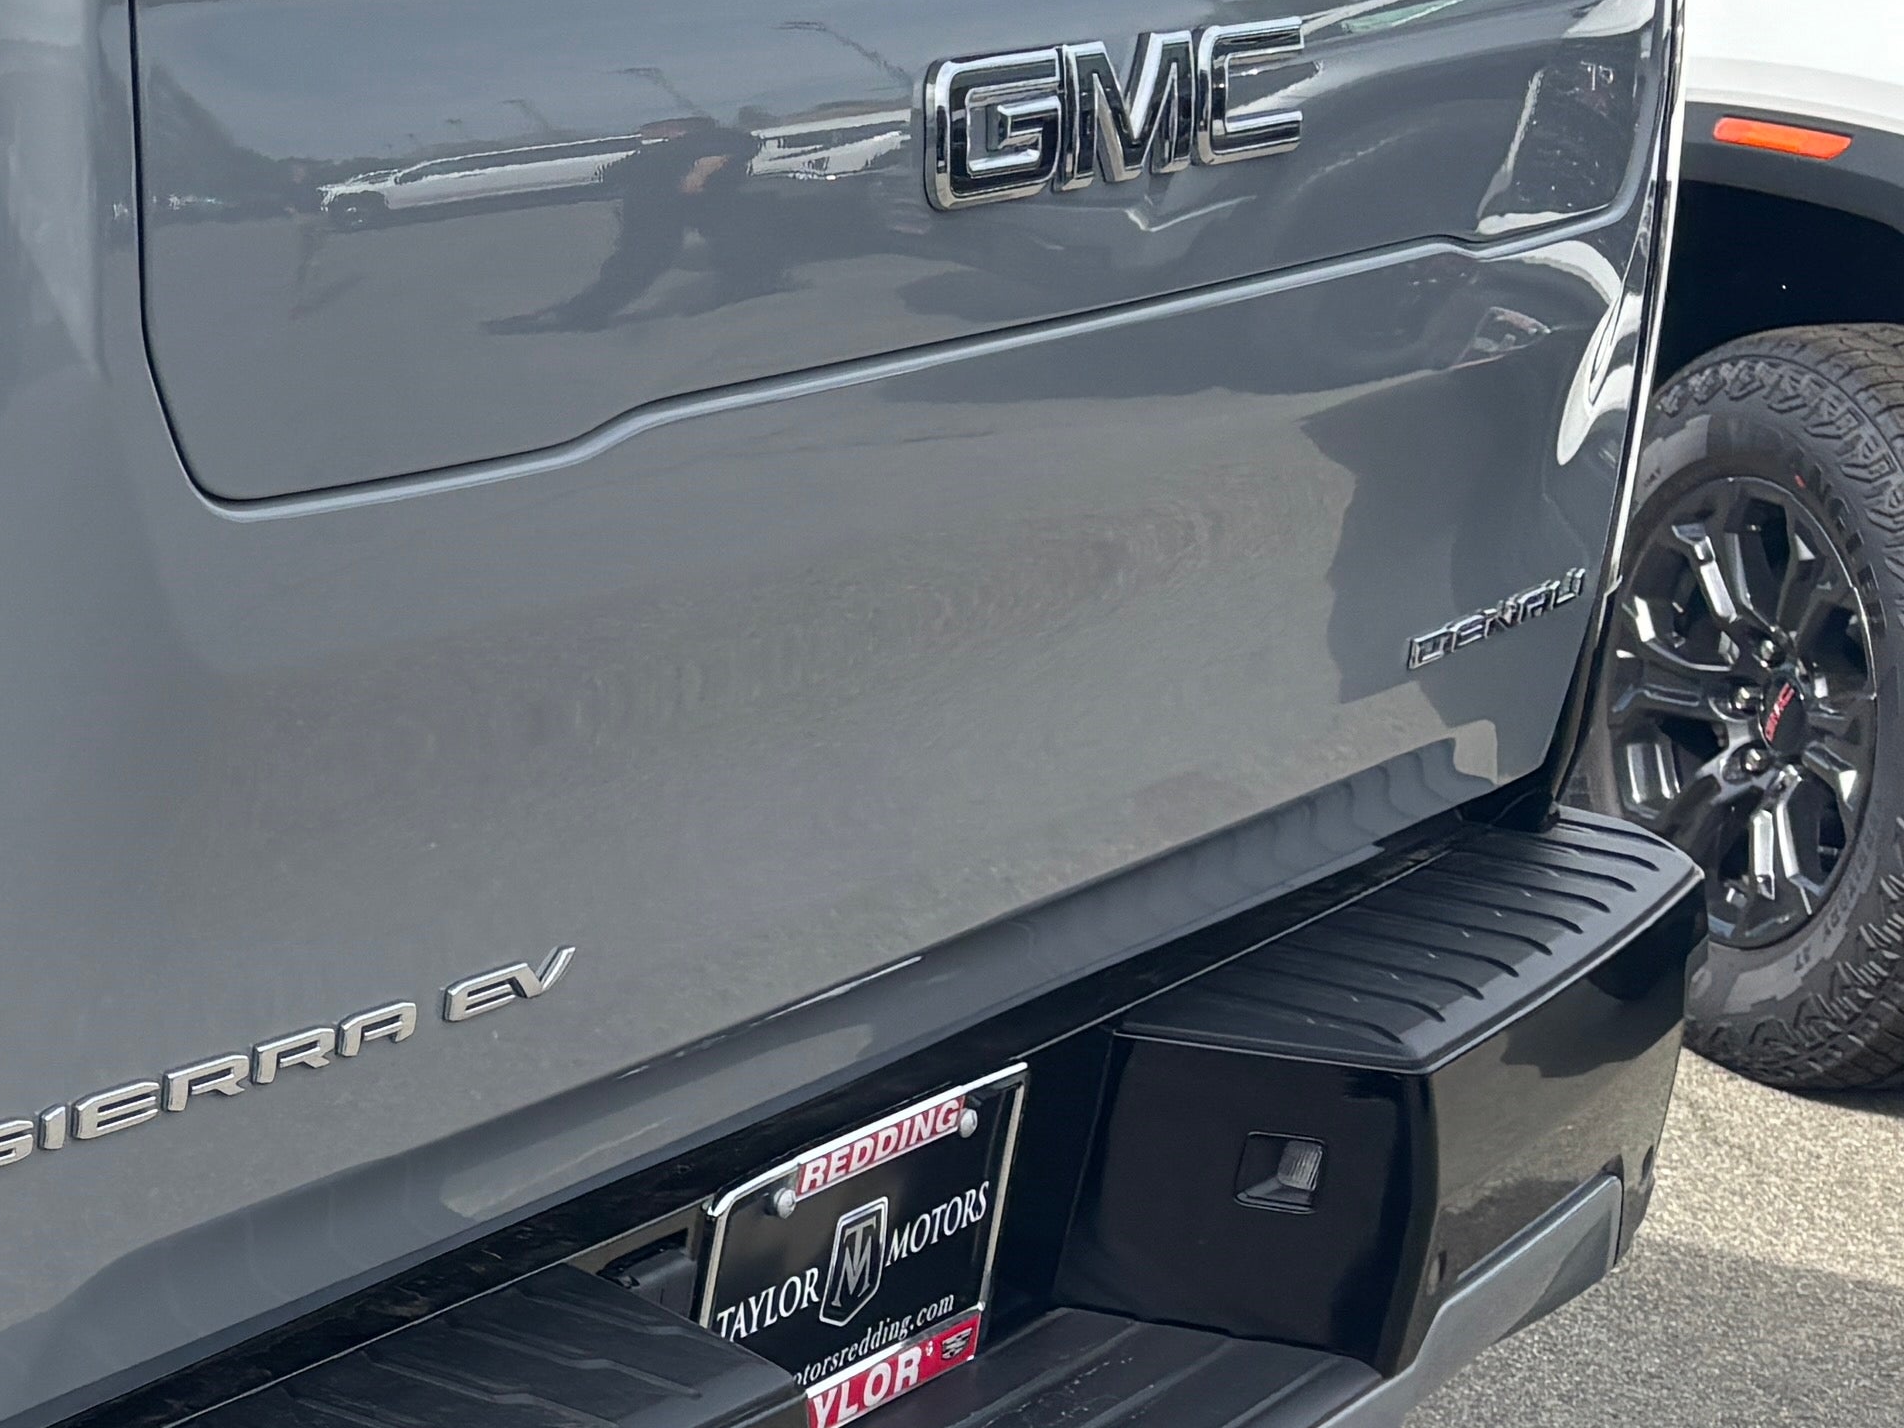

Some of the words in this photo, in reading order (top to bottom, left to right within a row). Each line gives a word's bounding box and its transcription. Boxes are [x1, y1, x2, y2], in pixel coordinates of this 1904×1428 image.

[923, 16, 1305, 210] GMC
[442, 944, 577, 1023] EV
[800, 1099, 963, 1194] REDDING
[716, 1267, 820, 1342] TAYLOR
[885, 1180, 990, 1268] MOTORS
